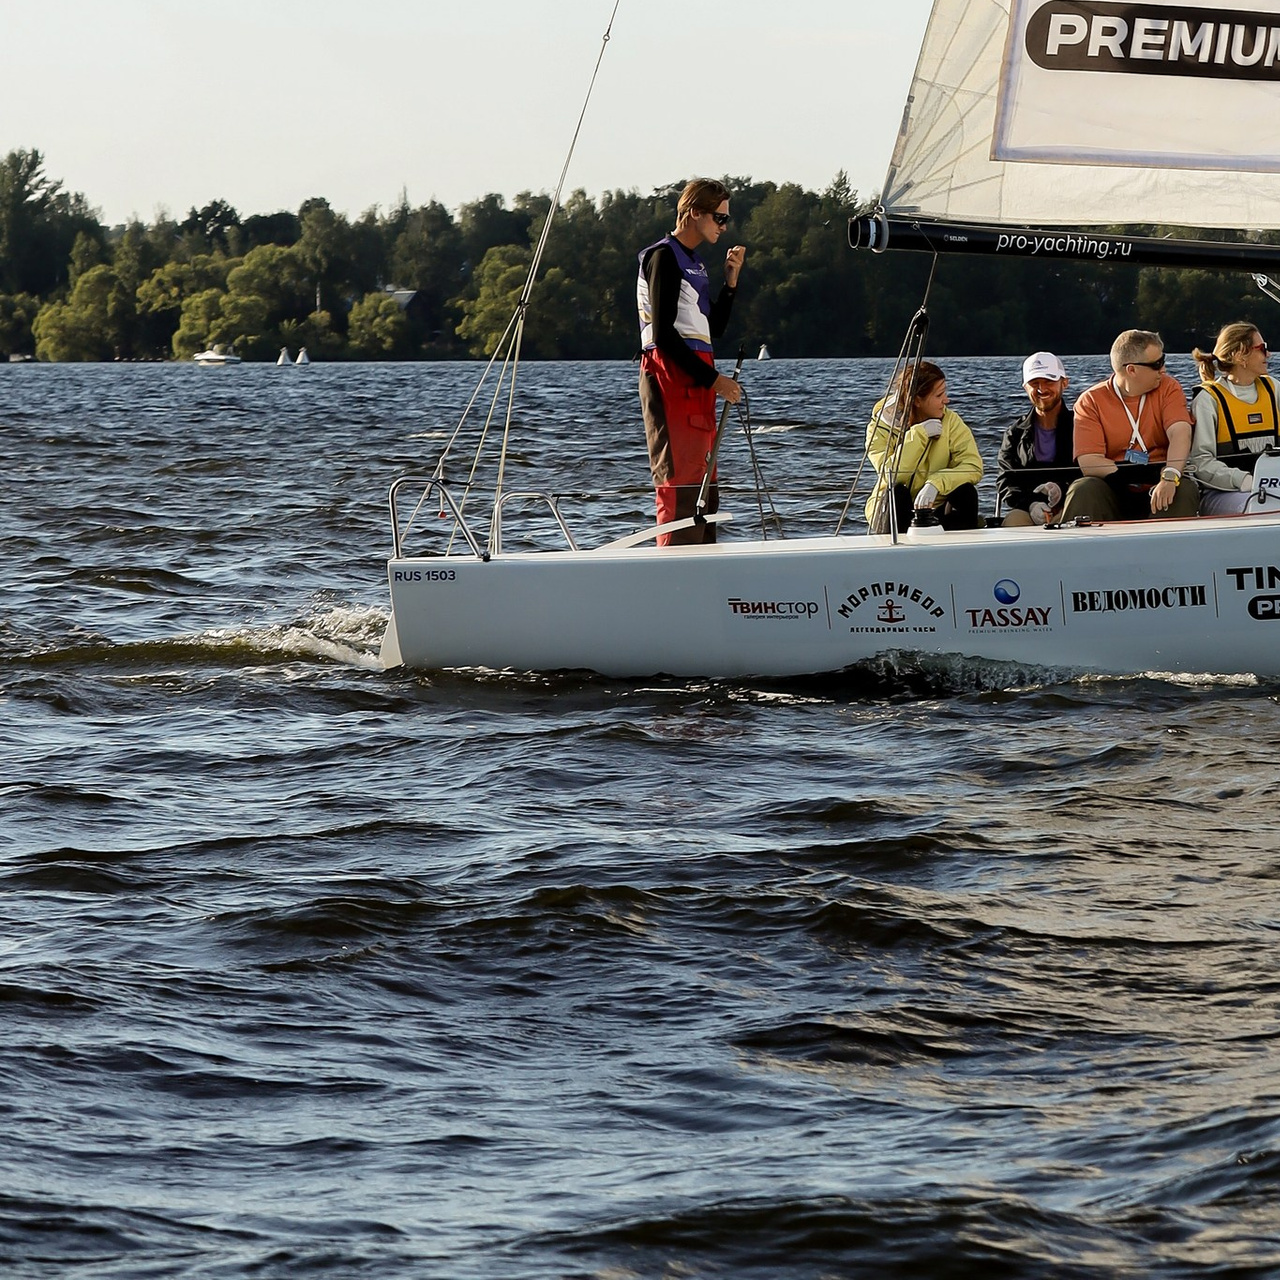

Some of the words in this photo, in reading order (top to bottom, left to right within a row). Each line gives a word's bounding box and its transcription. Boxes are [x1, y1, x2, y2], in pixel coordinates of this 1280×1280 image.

[996, 234, 1132, 259] pro-yachting.ru
[394, 570, 422, 581] RUS
[425, 570, 456, 581] 1503
[837, 582, 945, 619] МОРПРИБОР
[1072, 585, 1208, 613] ВЕДОМОСТИ
[965, 607, 1052, 627] TASSAY
